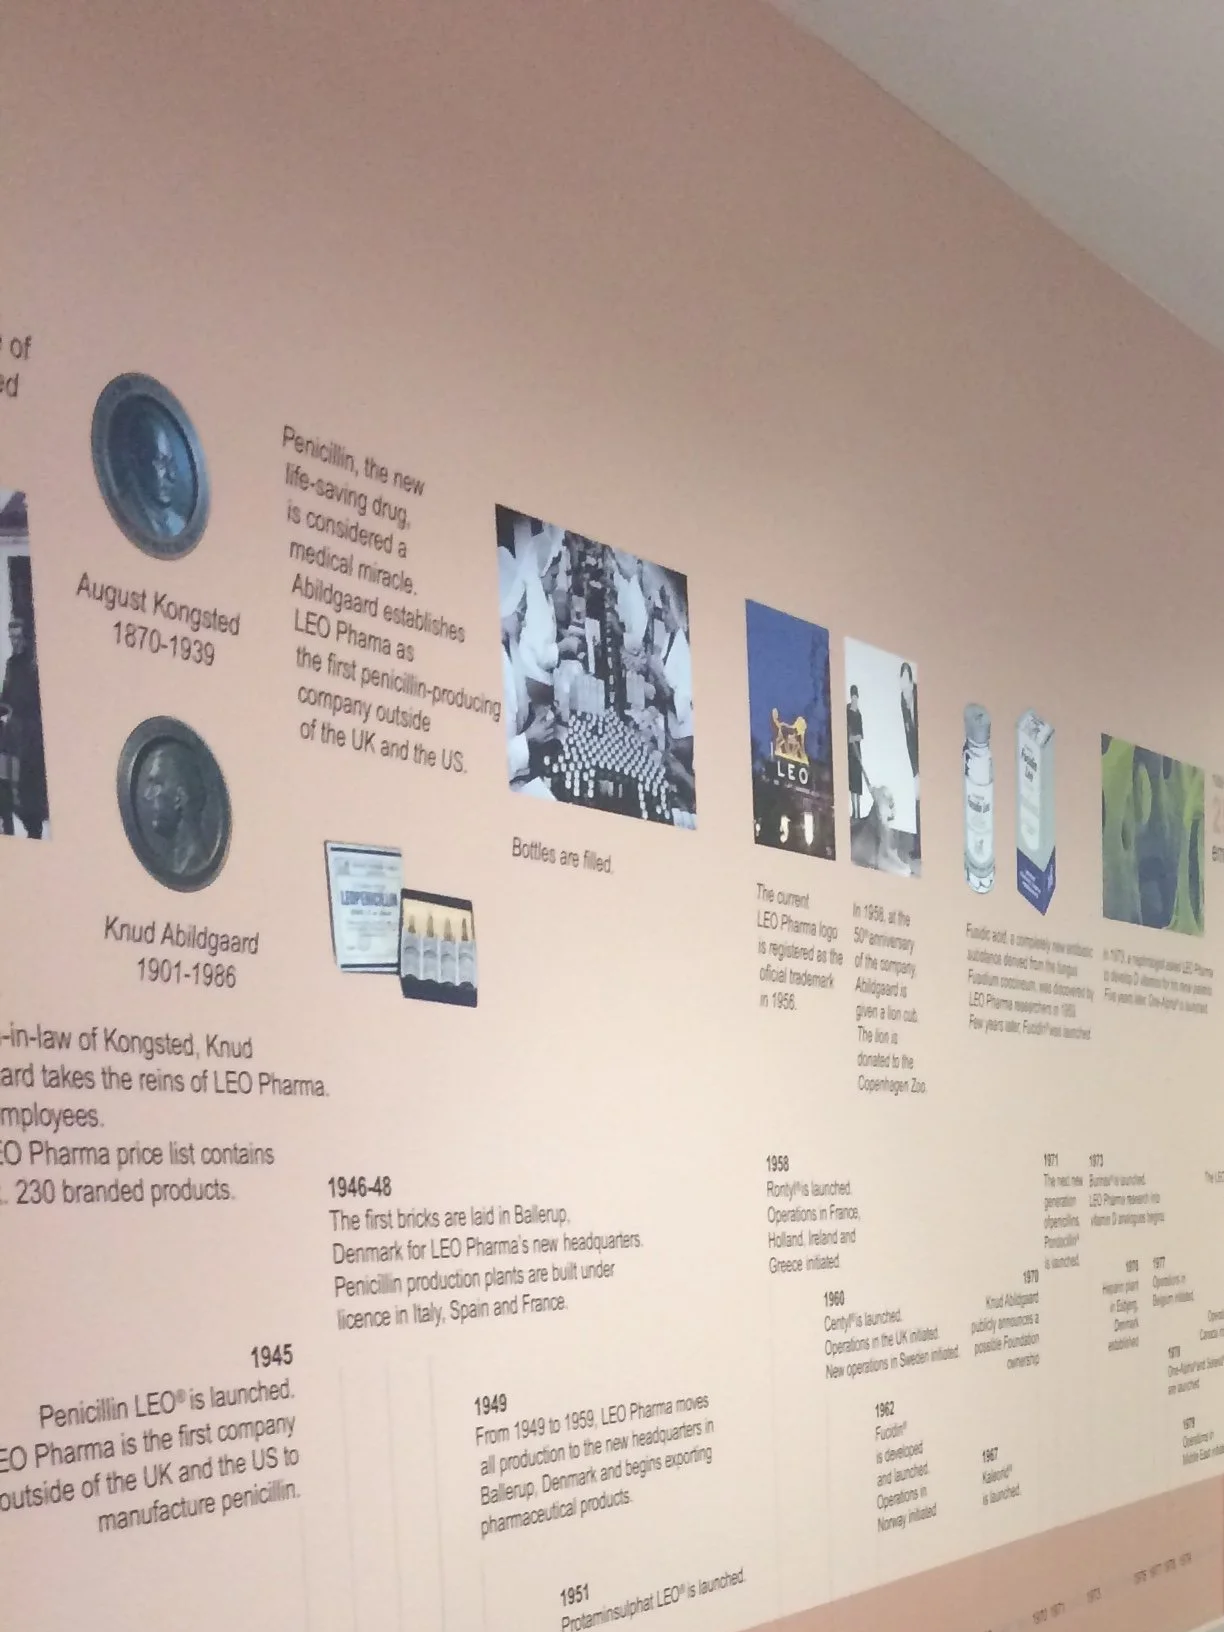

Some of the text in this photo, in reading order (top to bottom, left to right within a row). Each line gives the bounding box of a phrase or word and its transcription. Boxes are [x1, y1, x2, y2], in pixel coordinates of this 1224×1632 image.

[10, 337, 31, 359] of
[283, 424, 426, 496] Penicillin, the new
[286, 463, 368, 517] life-saving
[287, 501, 393, 555] is considered
[290, 540, 417, 595] medical miracle.
[76, 572, 240, 636] August Kongsted
[292, 573, 465, 643] Abildgaard establishes
[114, 621, 215, 666] 1870-1939
[294, 609, 331, 638] LEO
[397, 645, 414, 662] as
[296, 645, 502, 724] the first penicillin-producing
[298, 684, 430, 732] company outside
[300, 719, 467, 773] of the UK and the US.
[777, 762, 808, 785] LEO
[512, 835, 614, 875] Bottles are filled.
[105, 916, 259, 956] Knud Abildgaard
[138, 957, 237, 988] 1901-1986
[78, 1026, 253, 1060] of Kongsted, Knud
[42, 1063, 329, 1097] takes the reins of LEO Pharma.
[30, 1141, 275, 1168] Pharma price list contains
[16, 1180, 236, 1206] 230 branded products.
[328, 1175, 392, 1198] 1946-48
[329, 1209, 360, 1231] The
[365, 1208, 393, 1229] first
[397, 1207, 440, 1229] bricks
[471, 1207, 494, 1225] laid
[333, 1241, 402, 1264] Denmark
[407, 1239, 426, 1261] for
[431, 1238, 461, 1259] LEO
[533, 1235, 558, 1254] new
[338, 1305, 391, 1330] licence
[413, 1300, 446, 1328] Italy,
[450, 1300, 489, 1324] Spain
[494, 1296, 518, 1316] and
[251, 1343, 293, 1368] 1945
[39, 1395, 128, 1428] Penicillin
[190, 1387, 206, 1411] is
[210, 1377, 295, 1407] launched.
[475, 1393, 507, 1416] 1949
[476, 1423, 509, 1446] From
[515, 1418, 545, 1440] 1949
[602, 1403, 626, 1425] LEO
[631, 1398, 672, 1420] Pharma
[676, 1393, 709, 1412] moves
[35, 1414, 295, 1469] Pharma is the first company
[0, 1445, 299, 1511] outside of the UK and the US to
[98, 1479, 301, 1532] manufacture penicillin.
[481, 1488, 632, 1540] pharmaceutical products.
[561, 1583, 589, 1606] 1951
[687, 1582, 696, 1598] is
[699, 1567, 746, 1596] launched.
